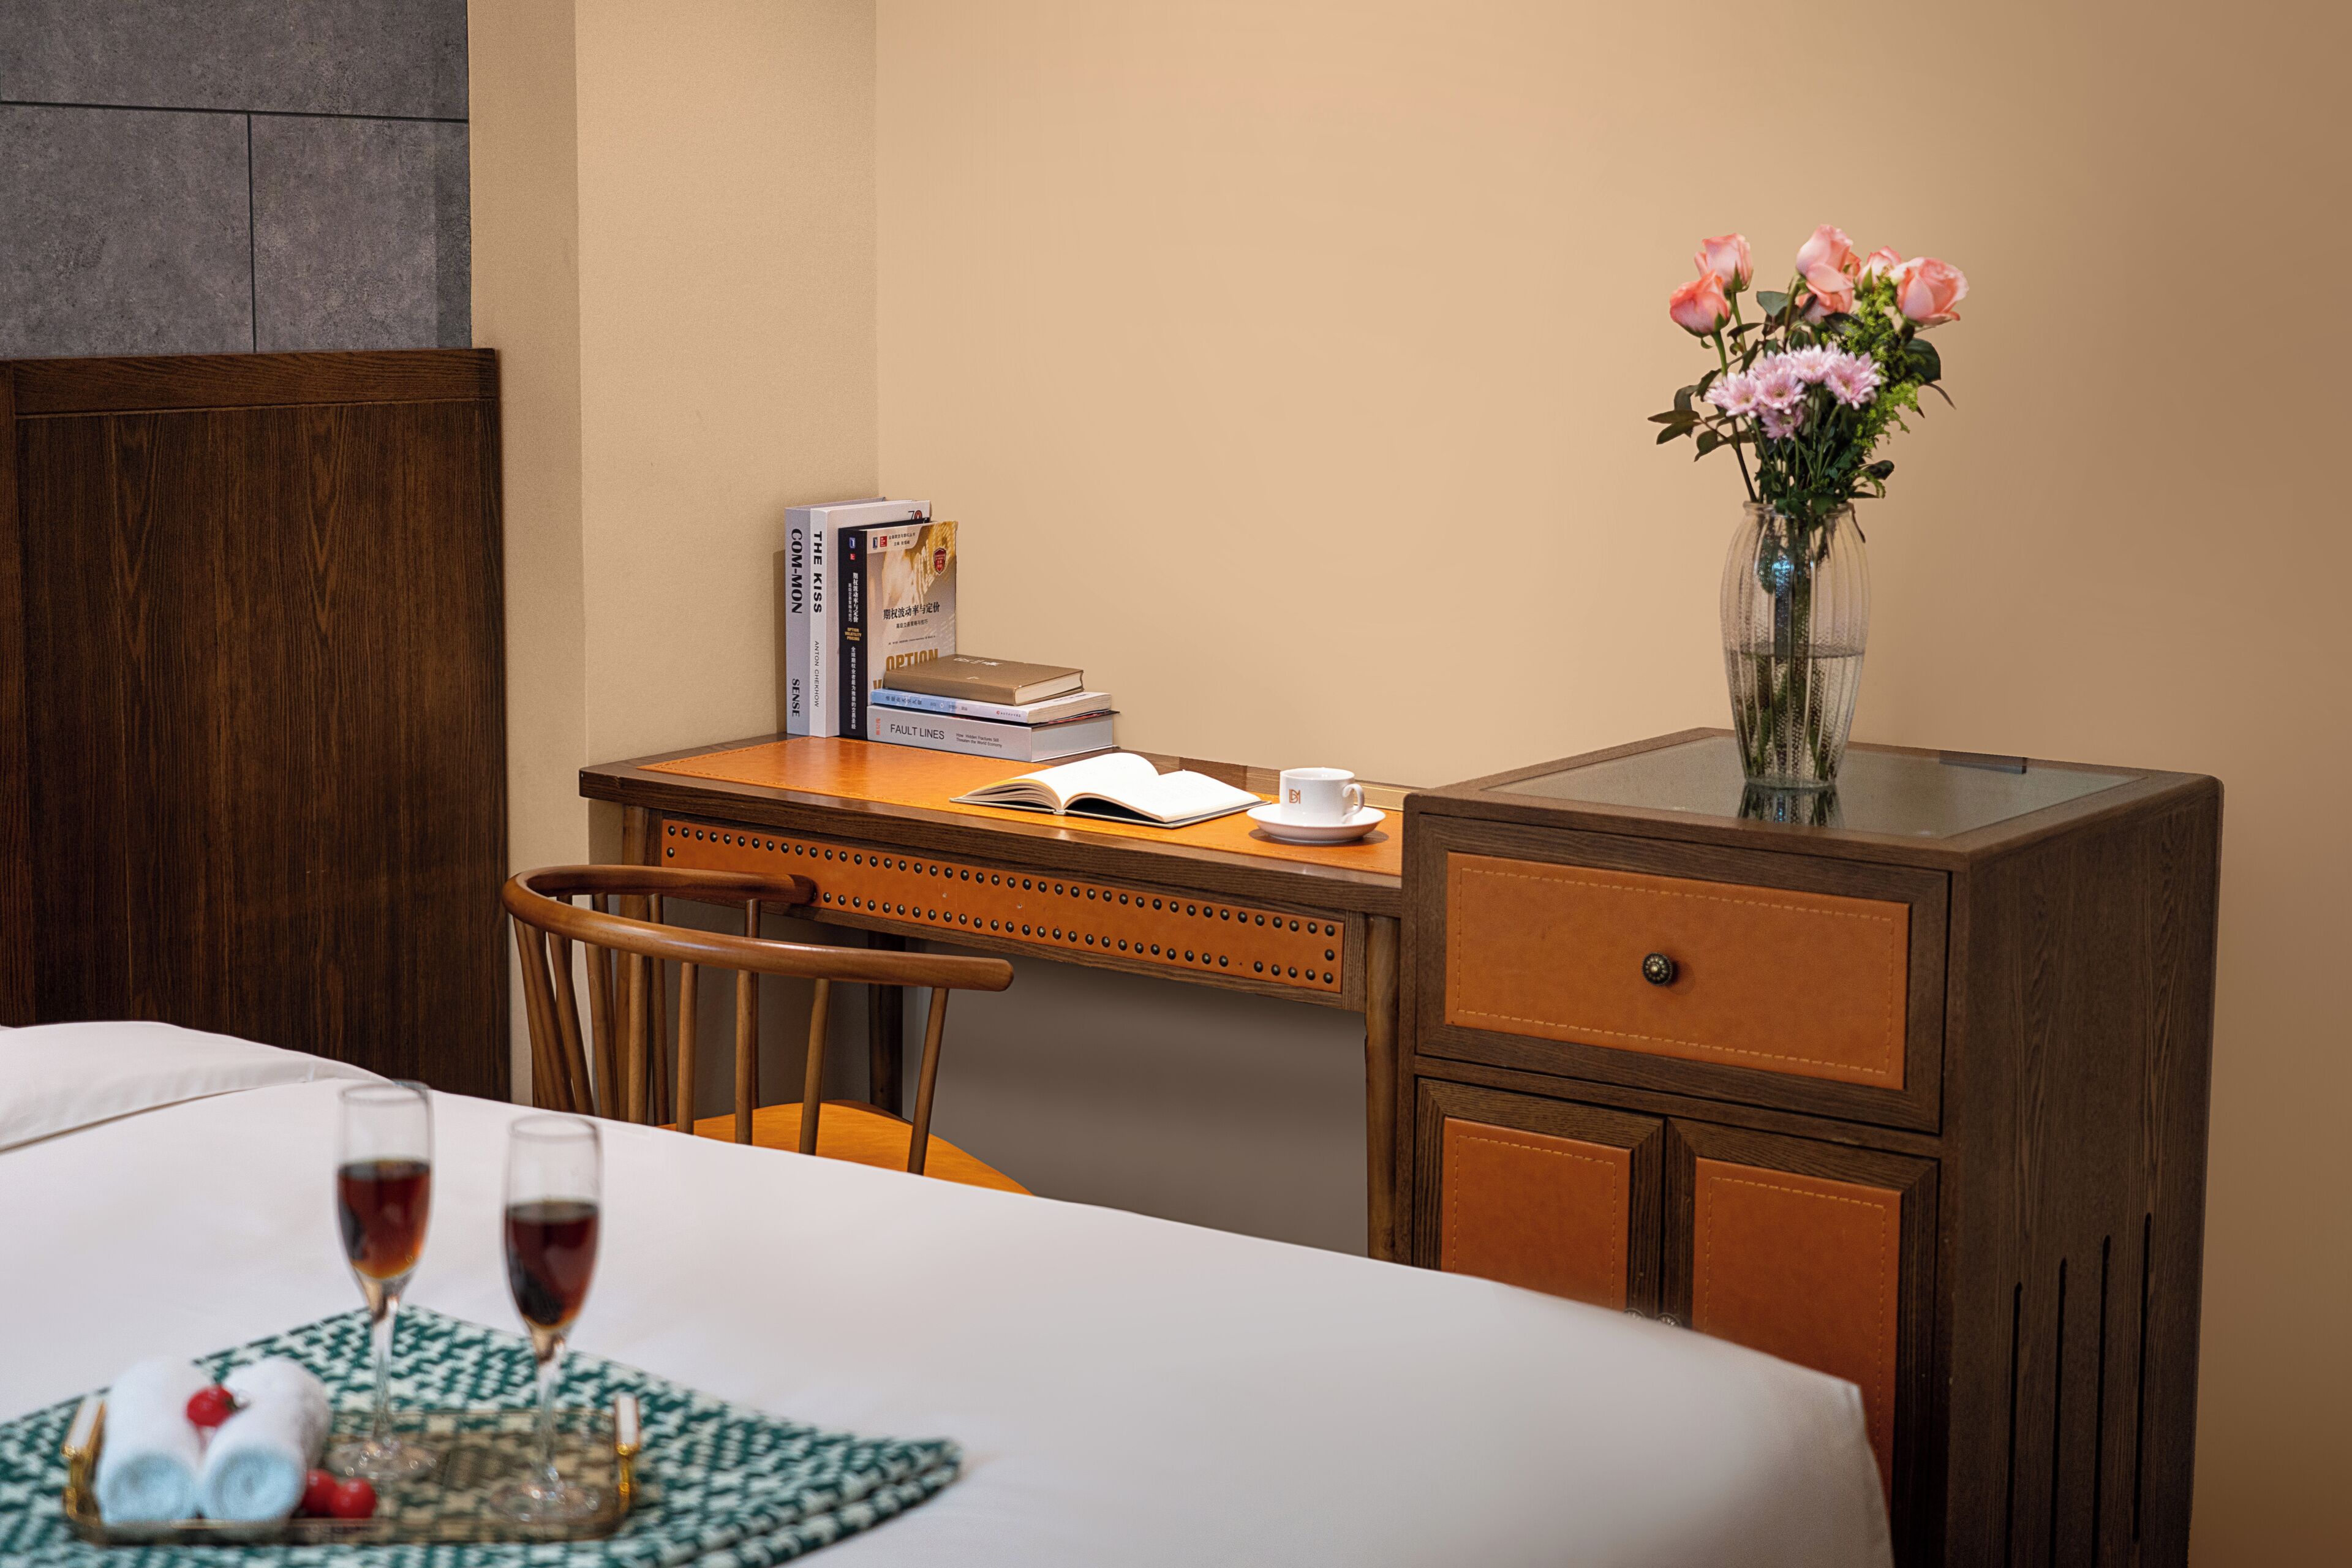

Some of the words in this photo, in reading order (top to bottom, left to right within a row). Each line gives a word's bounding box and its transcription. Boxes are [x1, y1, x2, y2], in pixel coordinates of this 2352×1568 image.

[813, 531, 822, 565] THE
[791, 529, 802, 614] COM-MON
[813, 573, 822, 613] KISS
[883, 601, 940, 620] 期权波动率与定价
[896, 619, 928, 628] 高级交易策略与技巧
[886, 648, 938, 671] OPTION
[791, 678, 800, 717] SENSE
[891, 724, 918, 736] FAULT
[919, 728, 944, 739] LINES
